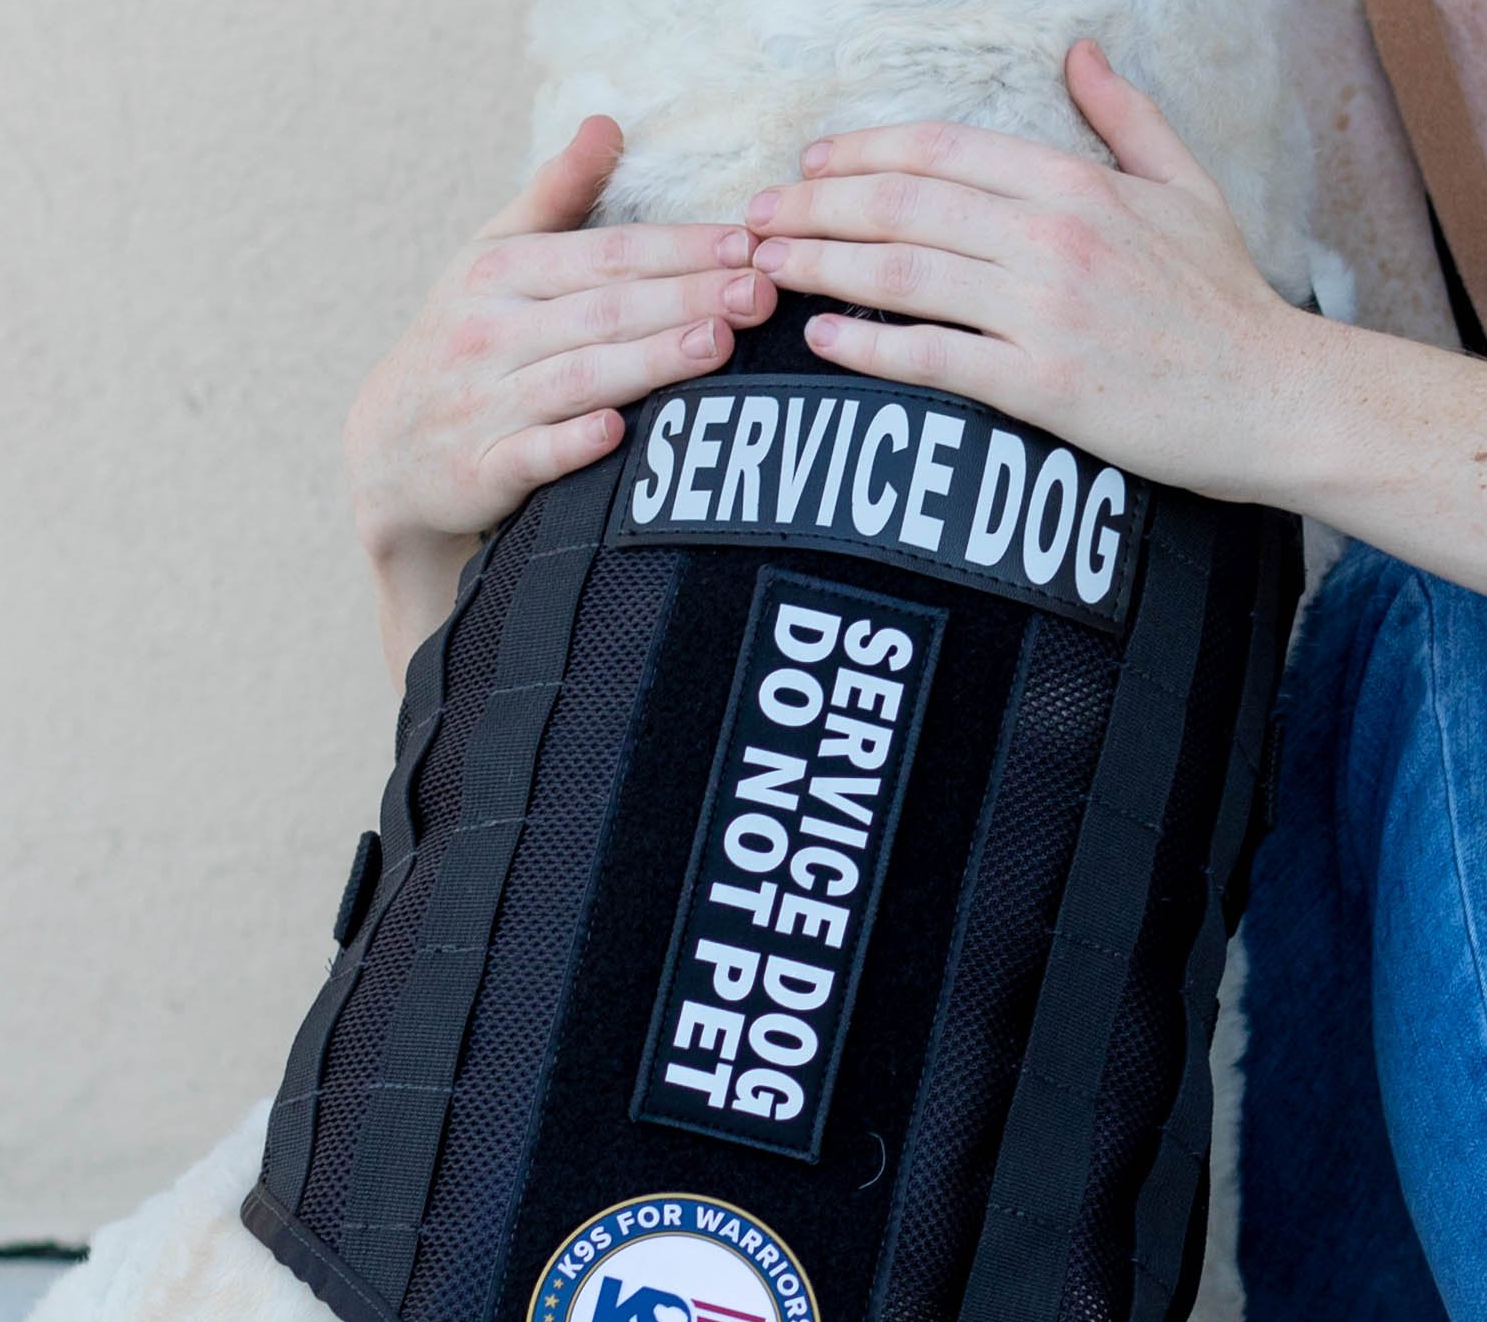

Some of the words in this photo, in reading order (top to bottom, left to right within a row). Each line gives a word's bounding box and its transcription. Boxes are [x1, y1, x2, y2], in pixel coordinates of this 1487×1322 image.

[632, 396, 966, 552] SERVICE
[964, 428, 1126, 605] DOG
[758, 603, 842, 727] DO
[709, 746, 808, 928] NOT
[774, 619, 913, 949] SERVICE
[664, 938, 761, 1109] PET
[731, 954, 835, 1121] DOG
[556, 1225, 613, 1281] K9S
[616, 1203, 683, 1236] FOR
